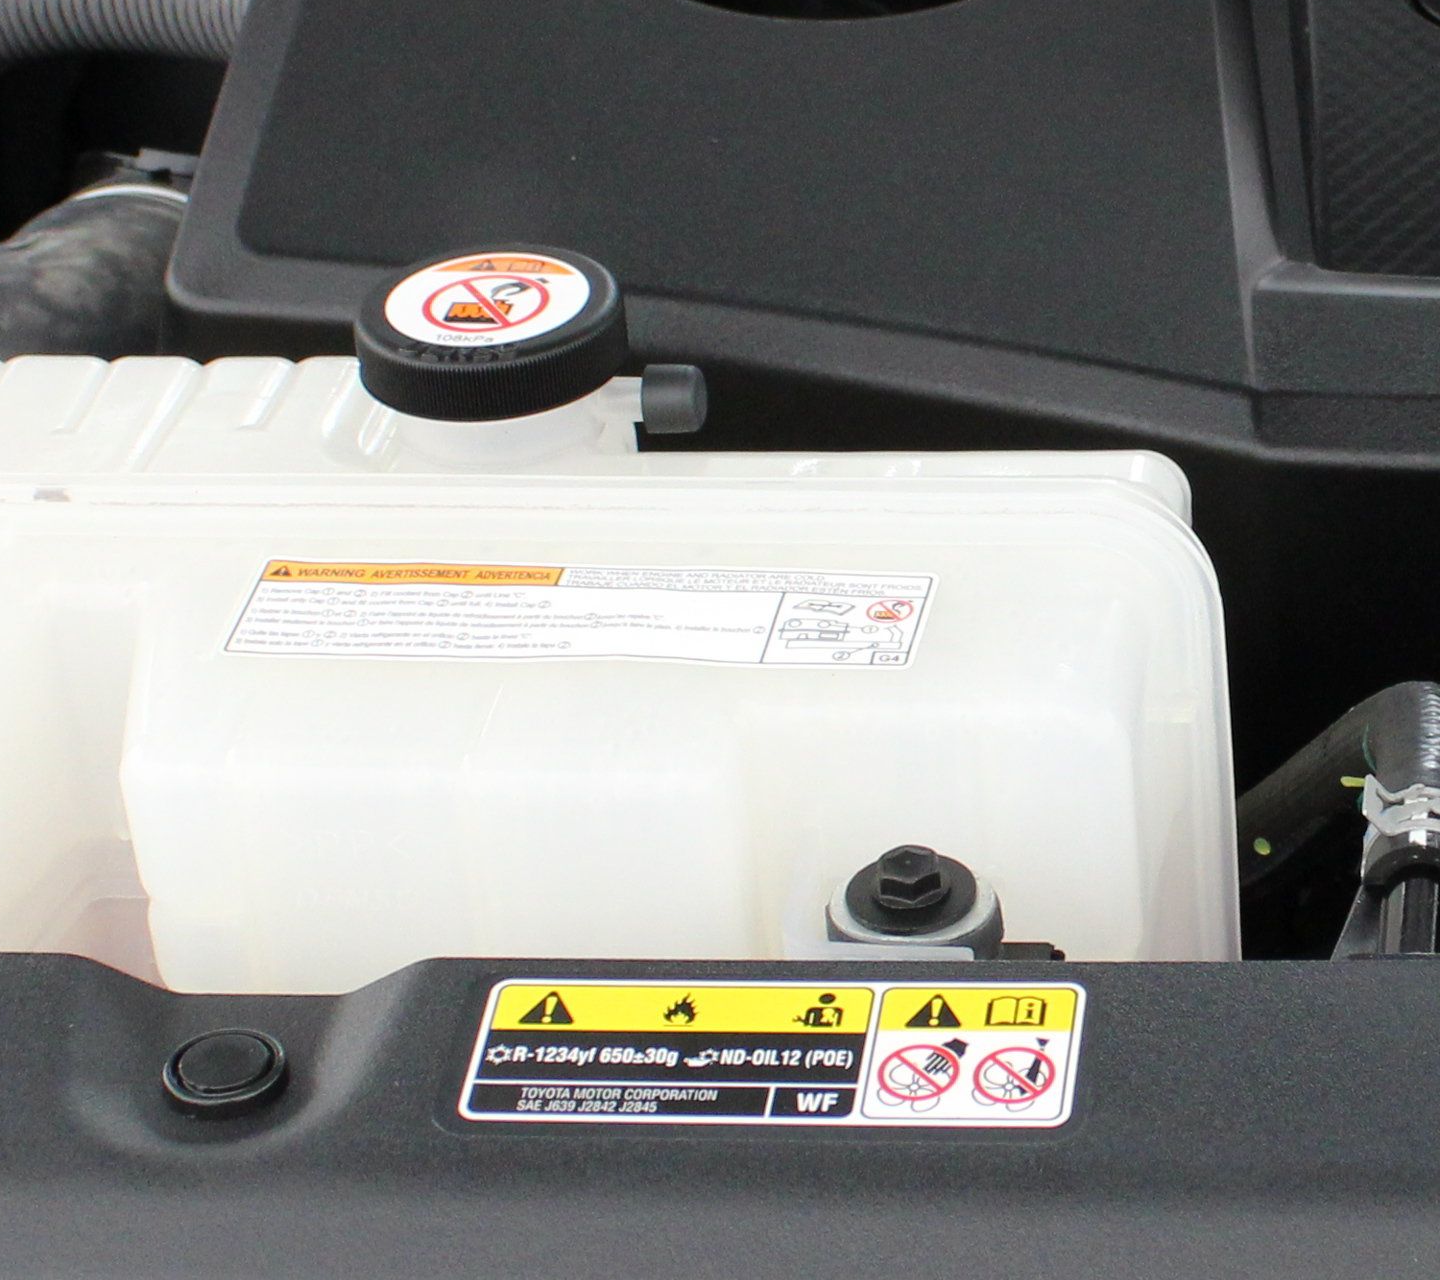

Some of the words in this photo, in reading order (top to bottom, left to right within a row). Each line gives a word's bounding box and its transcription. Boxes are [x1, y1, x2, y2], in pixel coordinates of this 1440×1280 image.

[297, 568, 365, 579] WARNING
[370, 568, 469, 580] AVERTISSEMENT
[475, 570, 552, 581] ADVERTENCIA
[879, 654, 900, 662] G4
[512, 1045, 598, 1067] R-1234yf
[599, 1046, 680, 1068] 650±30g
[719, 1048, 802, 1067] ND-OIL12
[804, 1049, 855, 1070] (POE)
[520, 1086, 571, 1100] TOYOTA
[573, 1087, 622, 1100] MOTOR
[623, 1088, 719, 1101] CORPORATION
[516, 1098, 542, 1111] SAE
[544, 1099, 576, 1112] J639
[577, 1100, 617, 1113] J2842
[618, 1101, 658, 1114] J2845
[796, 1092, 840, 1113] WF
